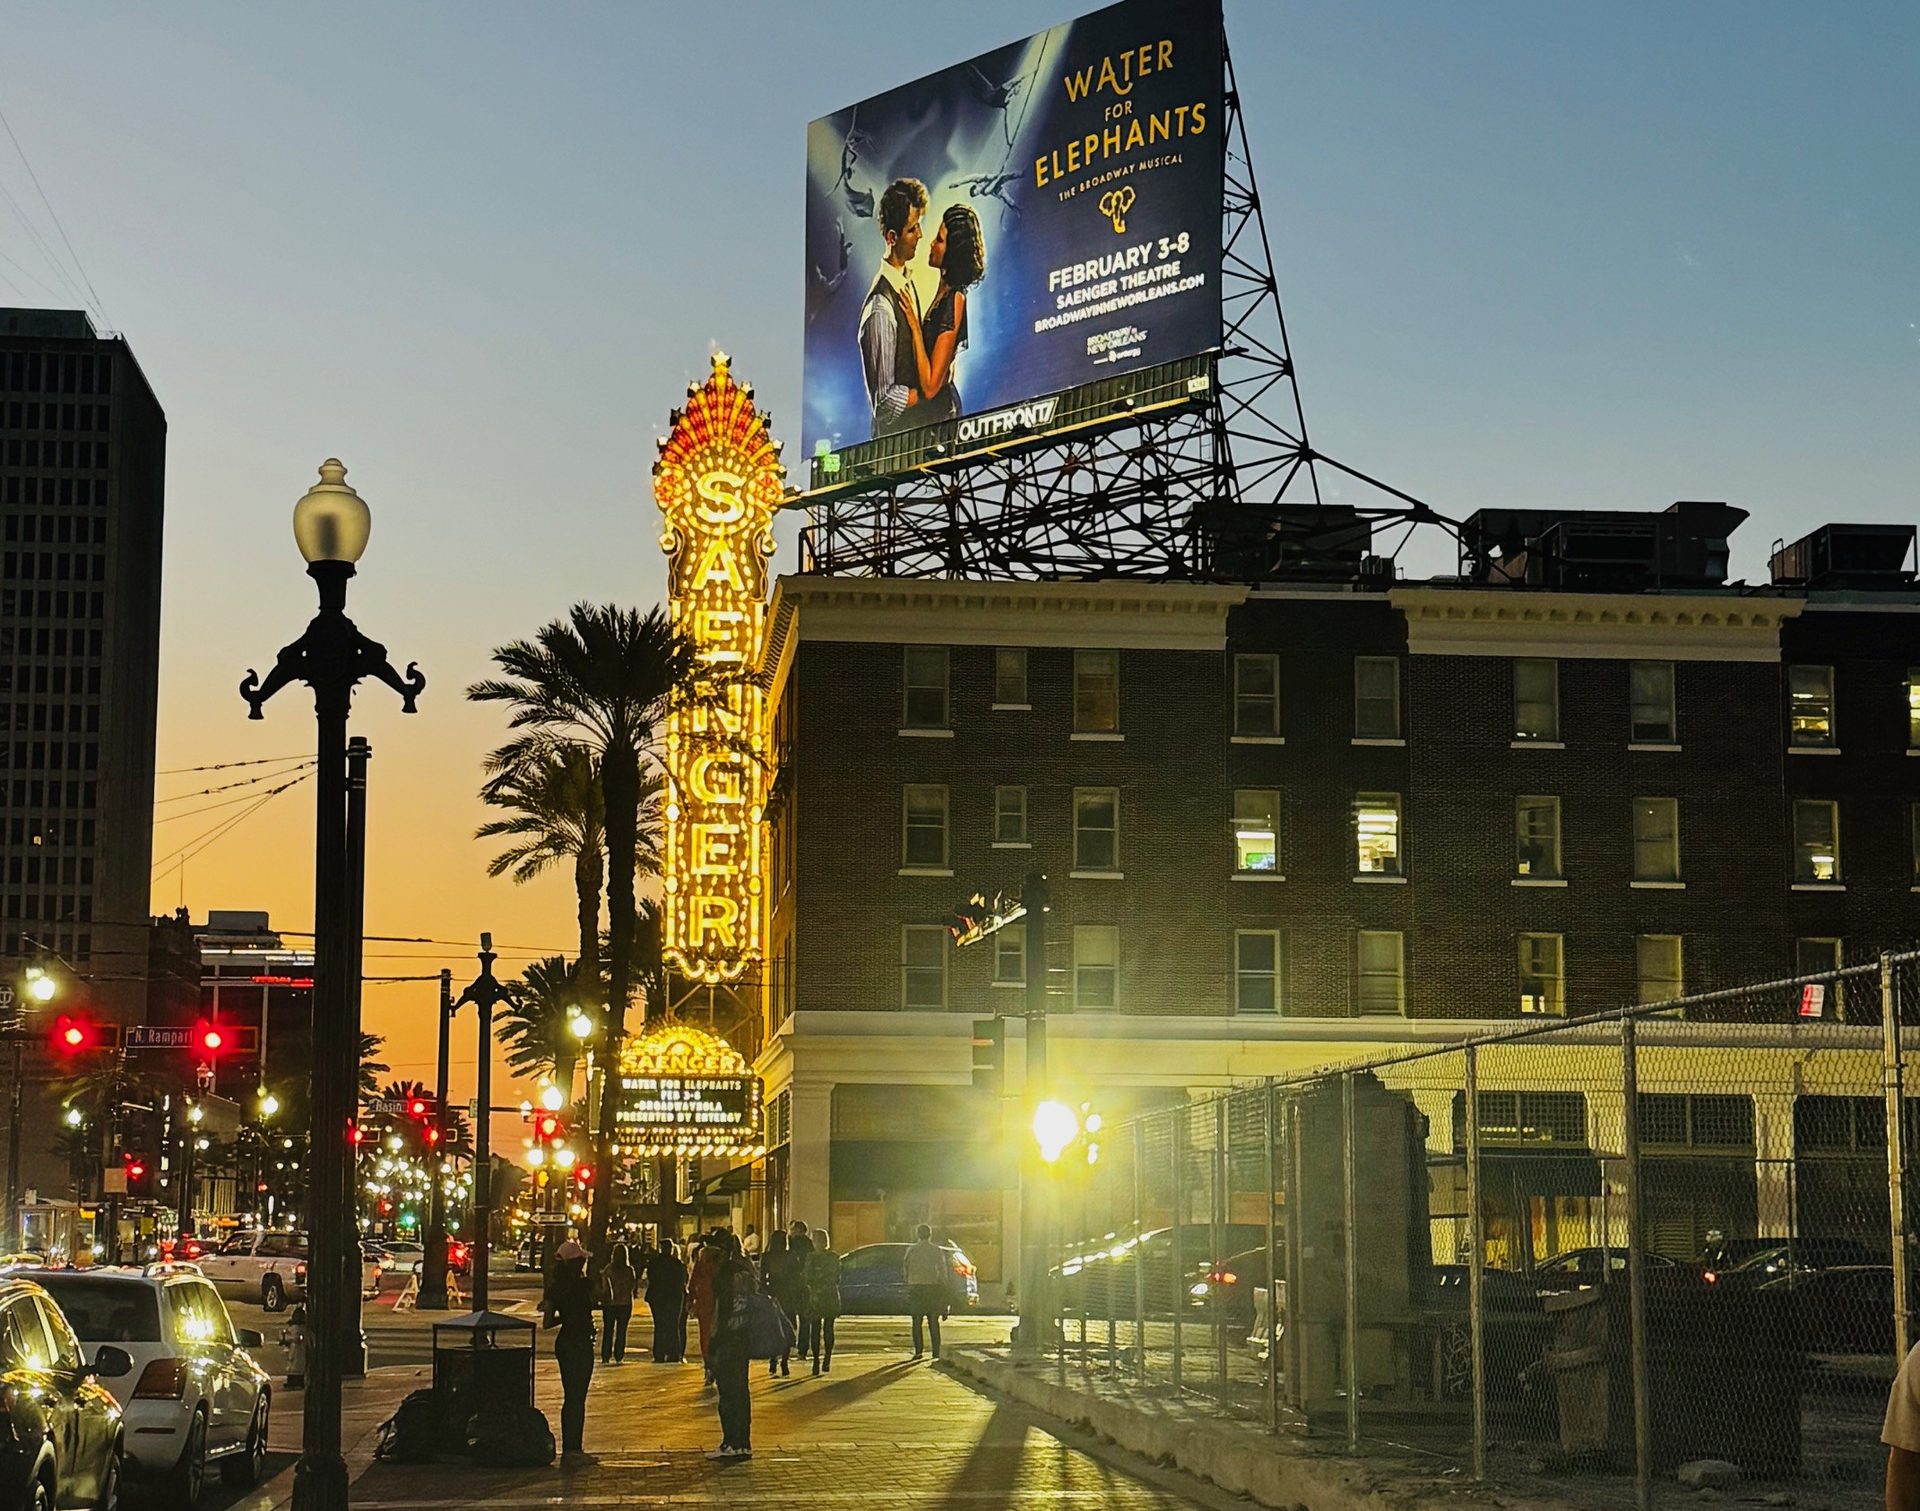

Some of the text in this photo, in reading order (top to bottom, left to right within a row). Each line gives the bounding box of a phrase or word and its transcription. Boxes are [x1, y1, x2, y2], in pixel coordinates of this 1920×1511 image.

[1064, 39, 1174, 103] WATER
[1104, 100, 1133, 122] FOR
[1035, 102, 1206, 188] ELEPHANTS
[1058, 153, 1183, 202] THE BROADWAY MUSICAL
[1049, 231, 1190, 293] FEBRUARY 3-8
[1056, 260, 1181, 310] SAENGER THEATRE
[1034, 272, 1206, 334] BROADWAYINNEWORLEANS.COM
[620, 1055, 737, 1071] SAENGER
[622, 1079, 742, 1091] WATER FOR ELEPHANTS
[376, 1099, 402, 1113] Basin
[616, 1112, 742, 1123] PRESENTED BY ENTERGY
